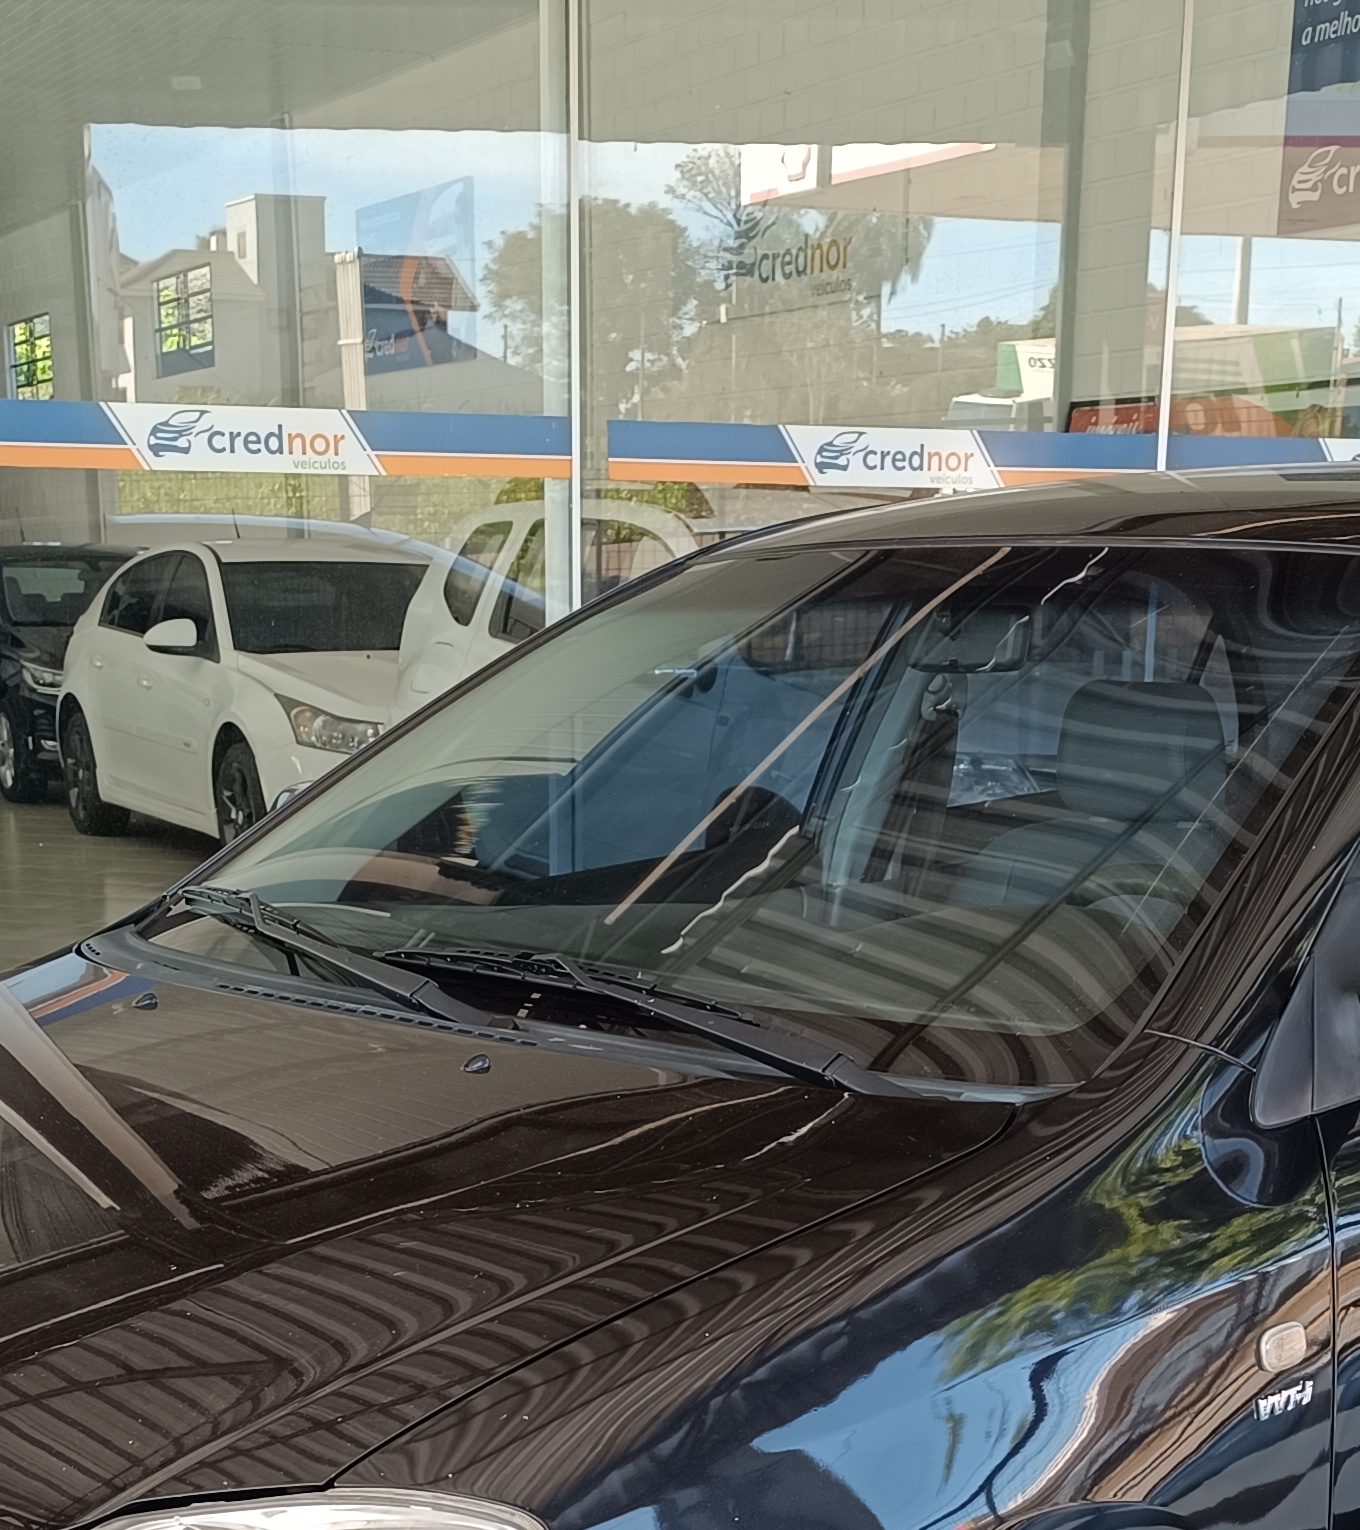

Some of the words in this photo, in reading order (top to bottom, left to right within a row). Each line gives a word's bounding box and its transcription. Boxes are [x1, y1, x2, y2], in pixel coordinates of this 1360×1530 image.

[1301, 26, 1313, 45] a
[758, 233, 852, 284] crednor
[207, 424, 346, 456] crednor
[292, 457, 347, 470] veículos
[862, 444, 974, 472] crednor
[929, 473, 974, 485] veículos
